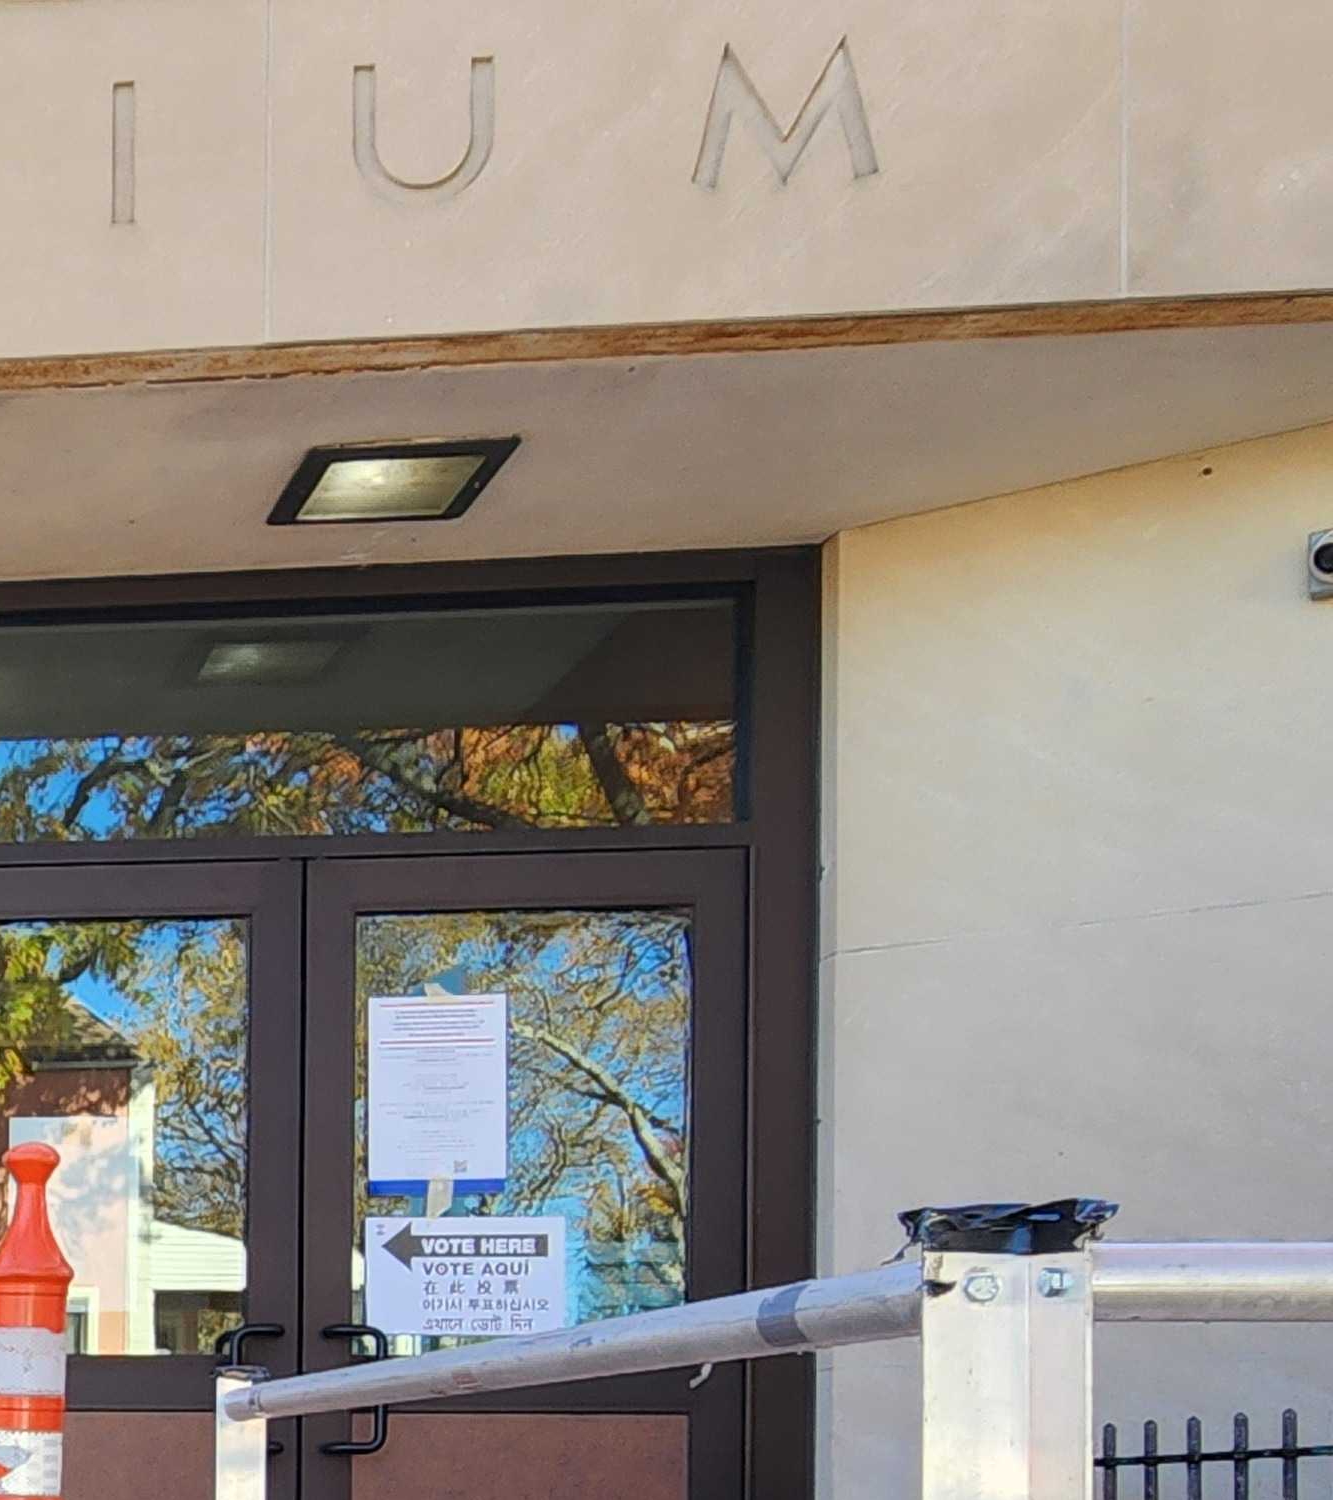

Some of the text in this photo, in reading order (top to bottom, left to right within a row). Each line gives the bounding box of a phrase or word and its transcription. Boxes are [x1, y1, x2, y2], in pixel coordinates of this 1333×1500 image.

[421, 1237, 537, 1254] VOTE HERE
[422, 1261, 475, 1276] VOTE
[423, 1279, 519, 1295] 在此投票
